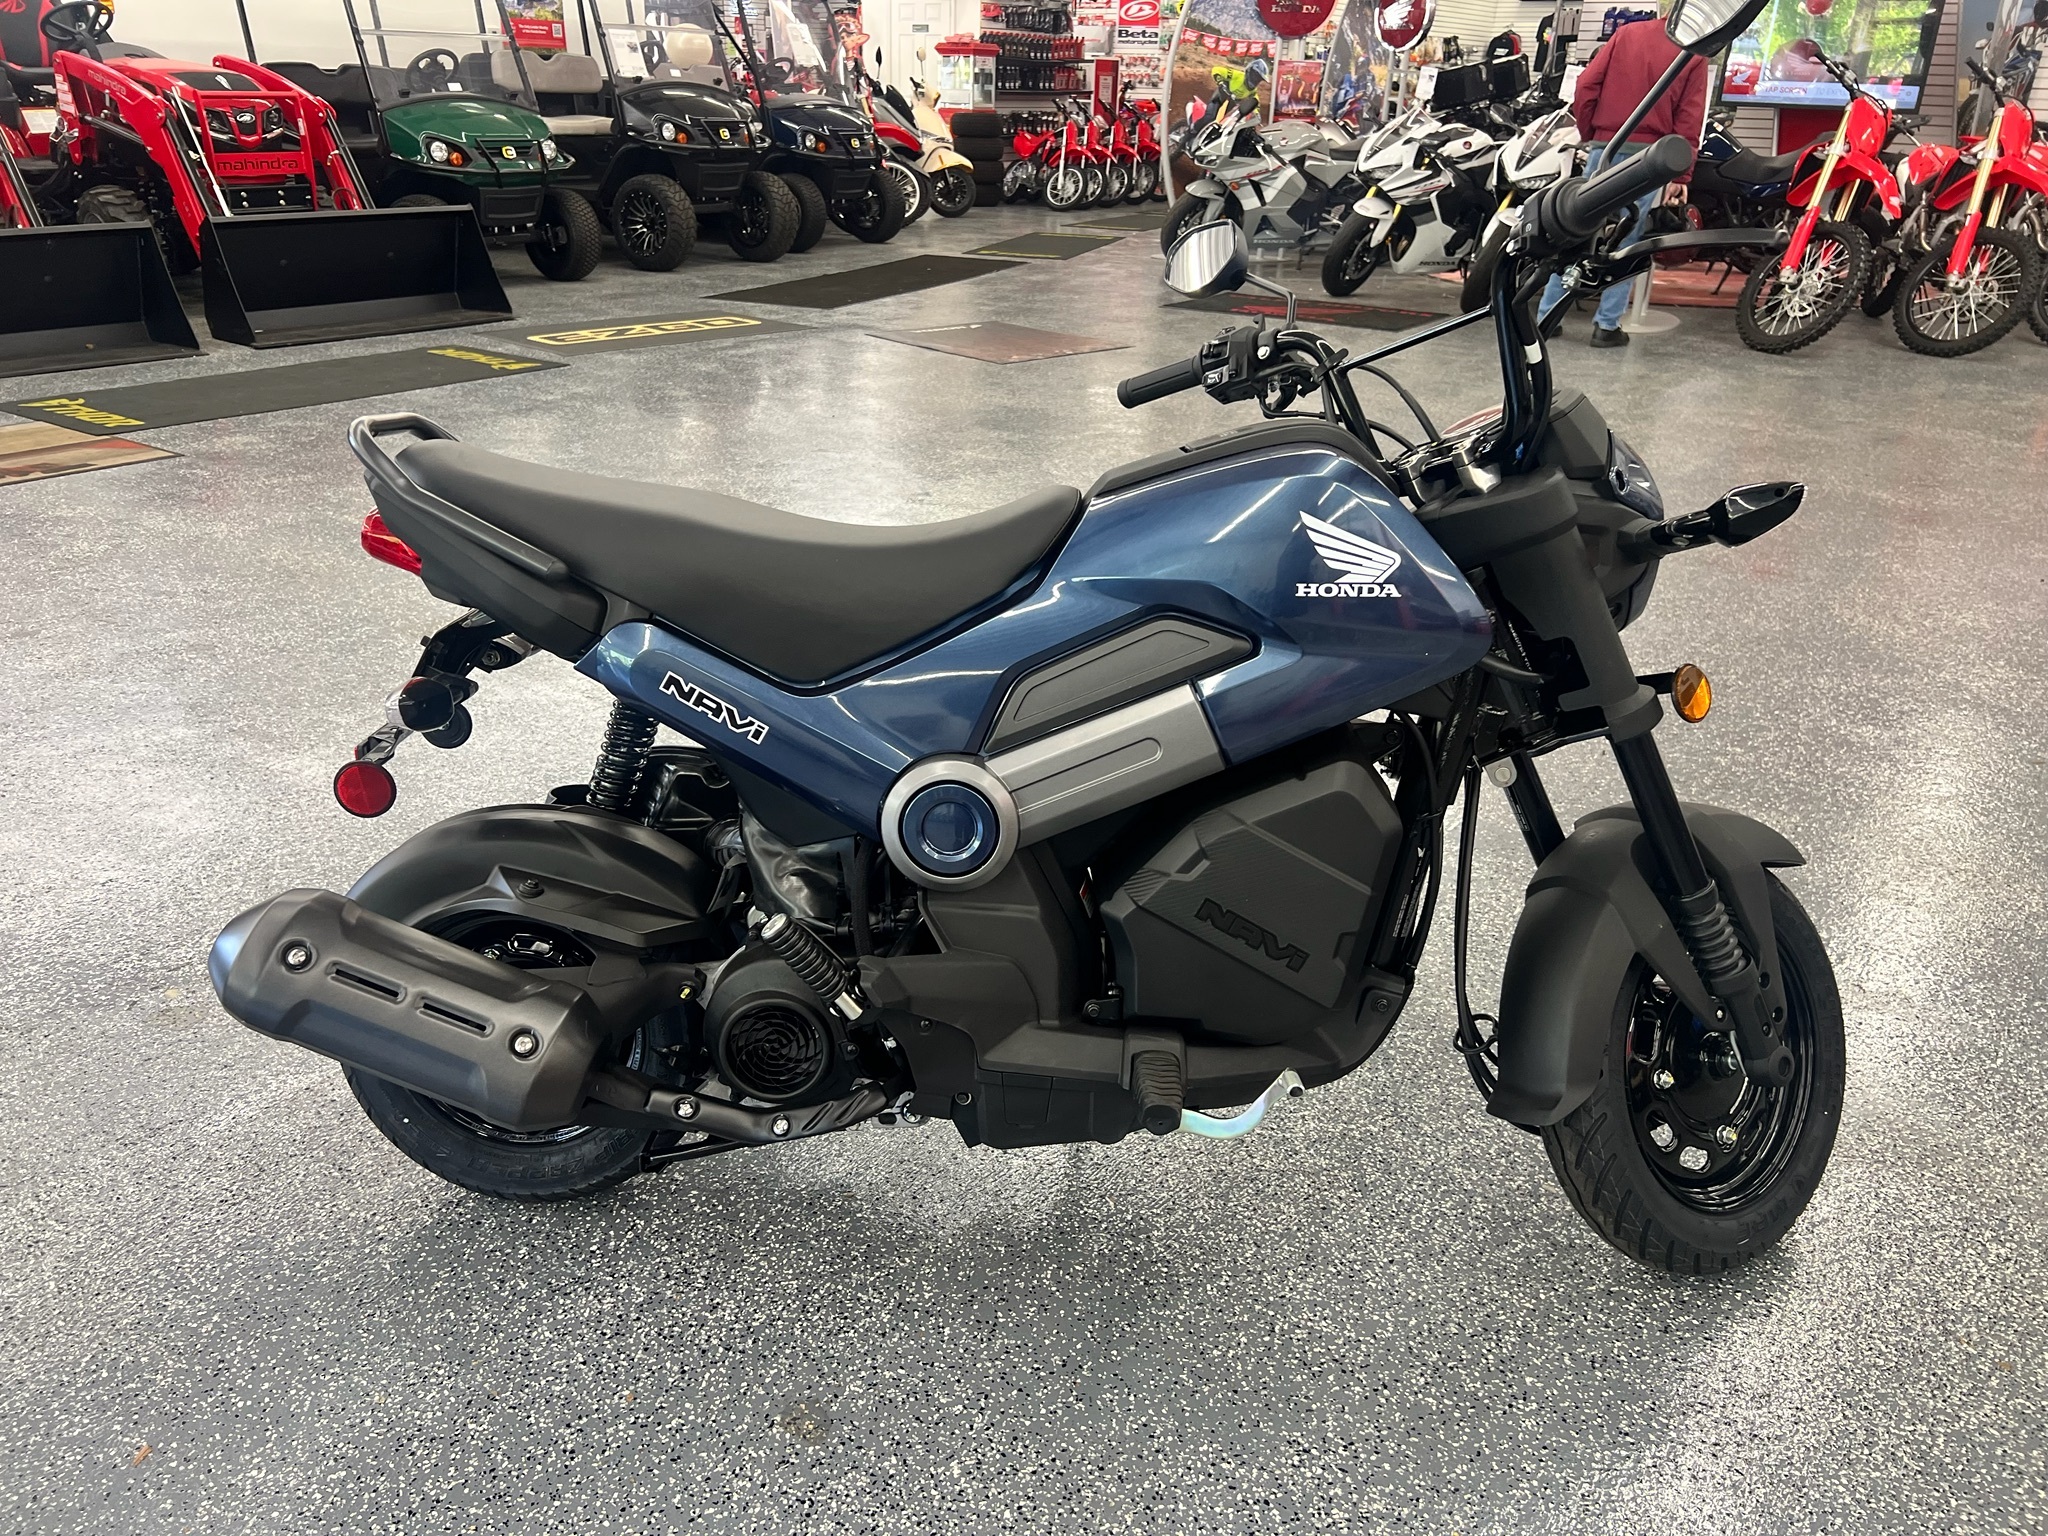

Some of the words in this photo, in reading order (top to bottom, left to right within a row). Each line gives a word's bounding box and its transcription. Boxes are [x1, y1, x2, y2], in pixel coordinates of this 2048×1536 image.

[1117, 29, 1158, 38] Beta
[88, 70, 127, 95] mahindra
[217, 158, 298, 170] mahindra
[1295, 583, 1402, 598] HONDA
